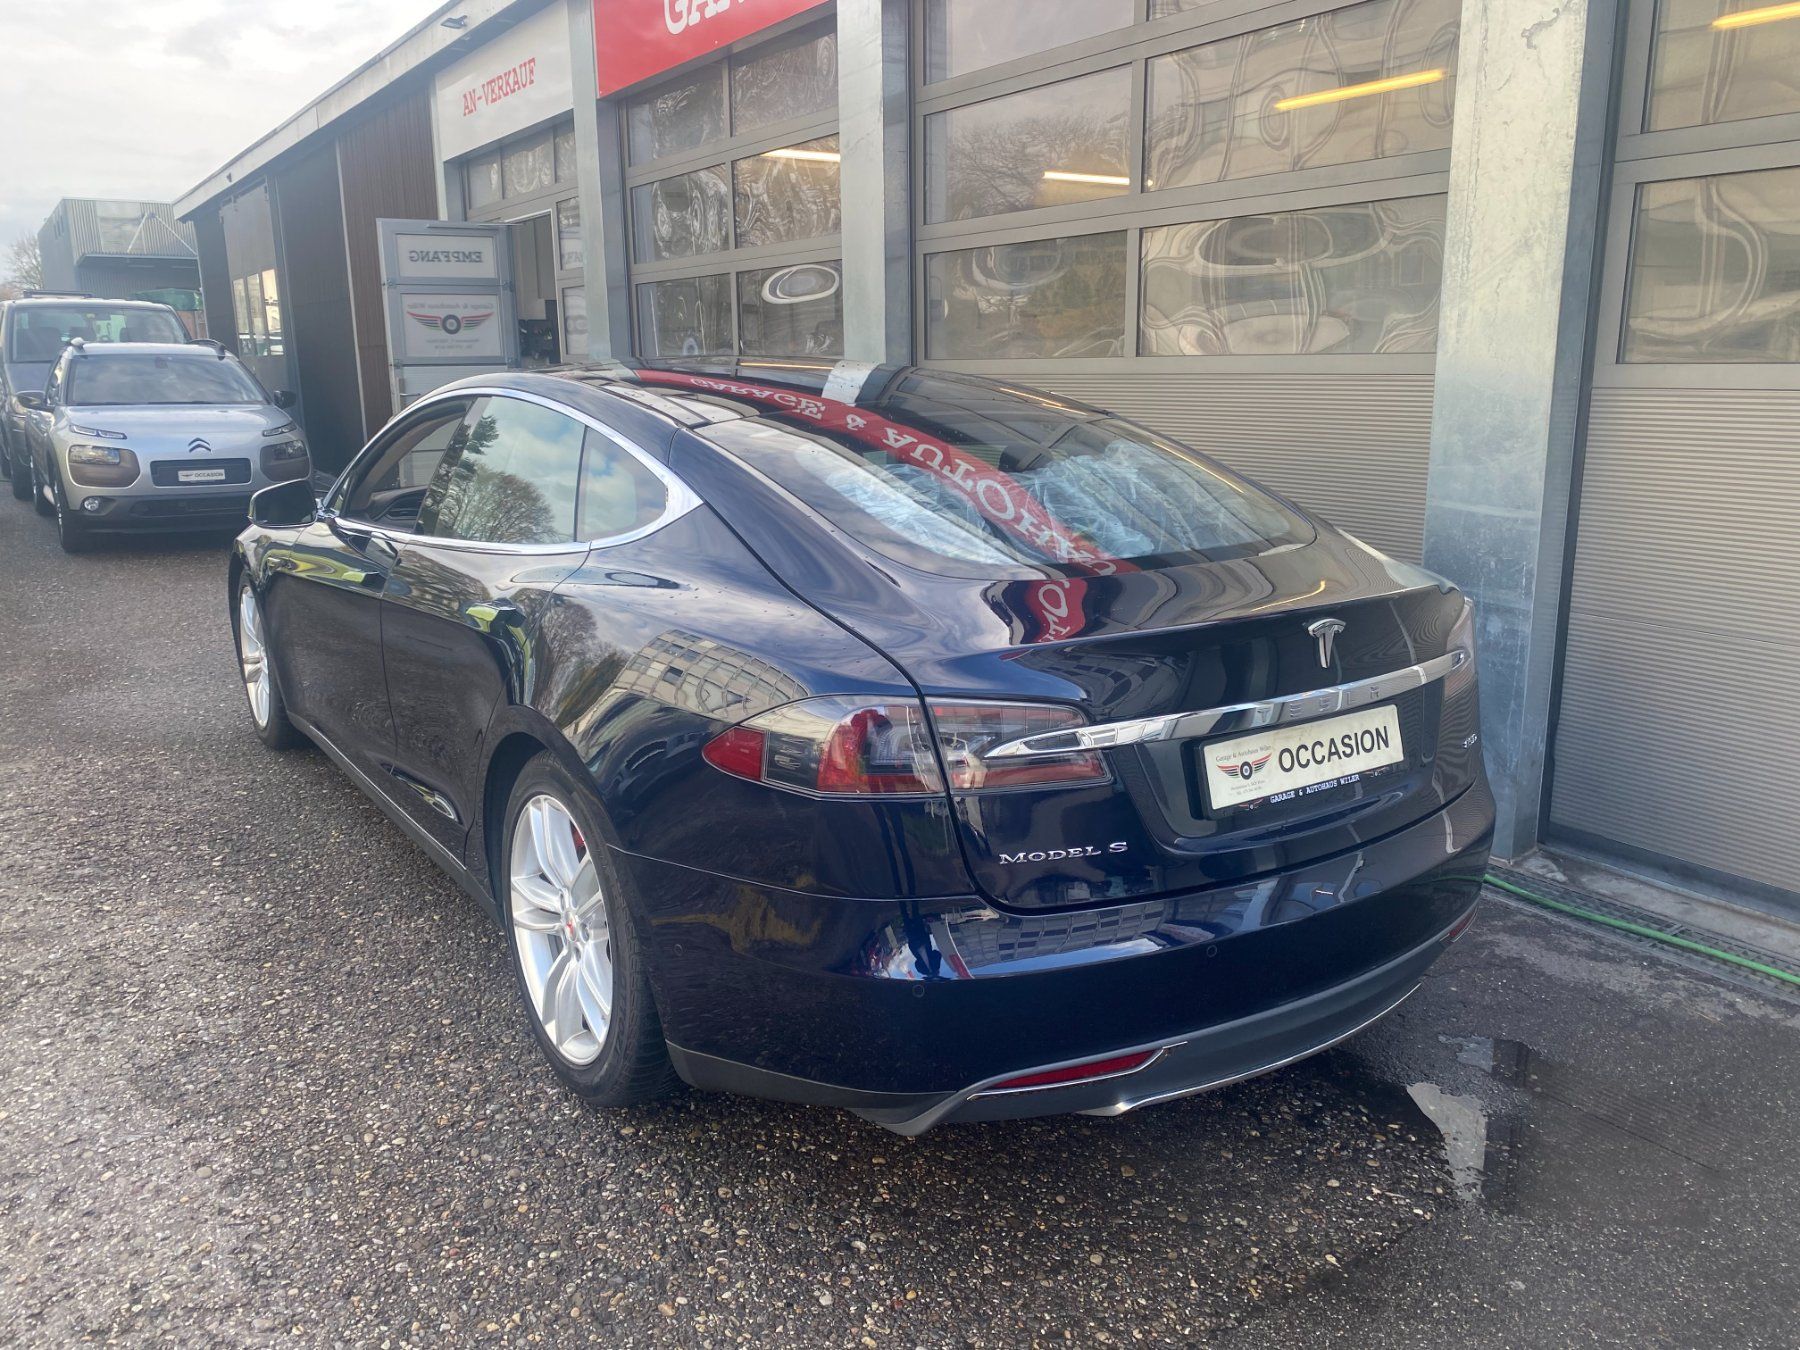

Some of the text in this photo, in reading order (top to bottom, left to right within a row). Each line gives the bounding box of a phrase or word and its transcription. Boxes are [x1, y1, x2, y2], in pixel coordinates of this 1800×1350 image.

[463, 57, 536, 117] AN-VERKAUF
[1278, 725, 1390, 773] OCCASION
[1269, 774, 1361, 804] GARAGE & AUTOHAUS WILER
[998, 841, 1129, 865] MODEL S
